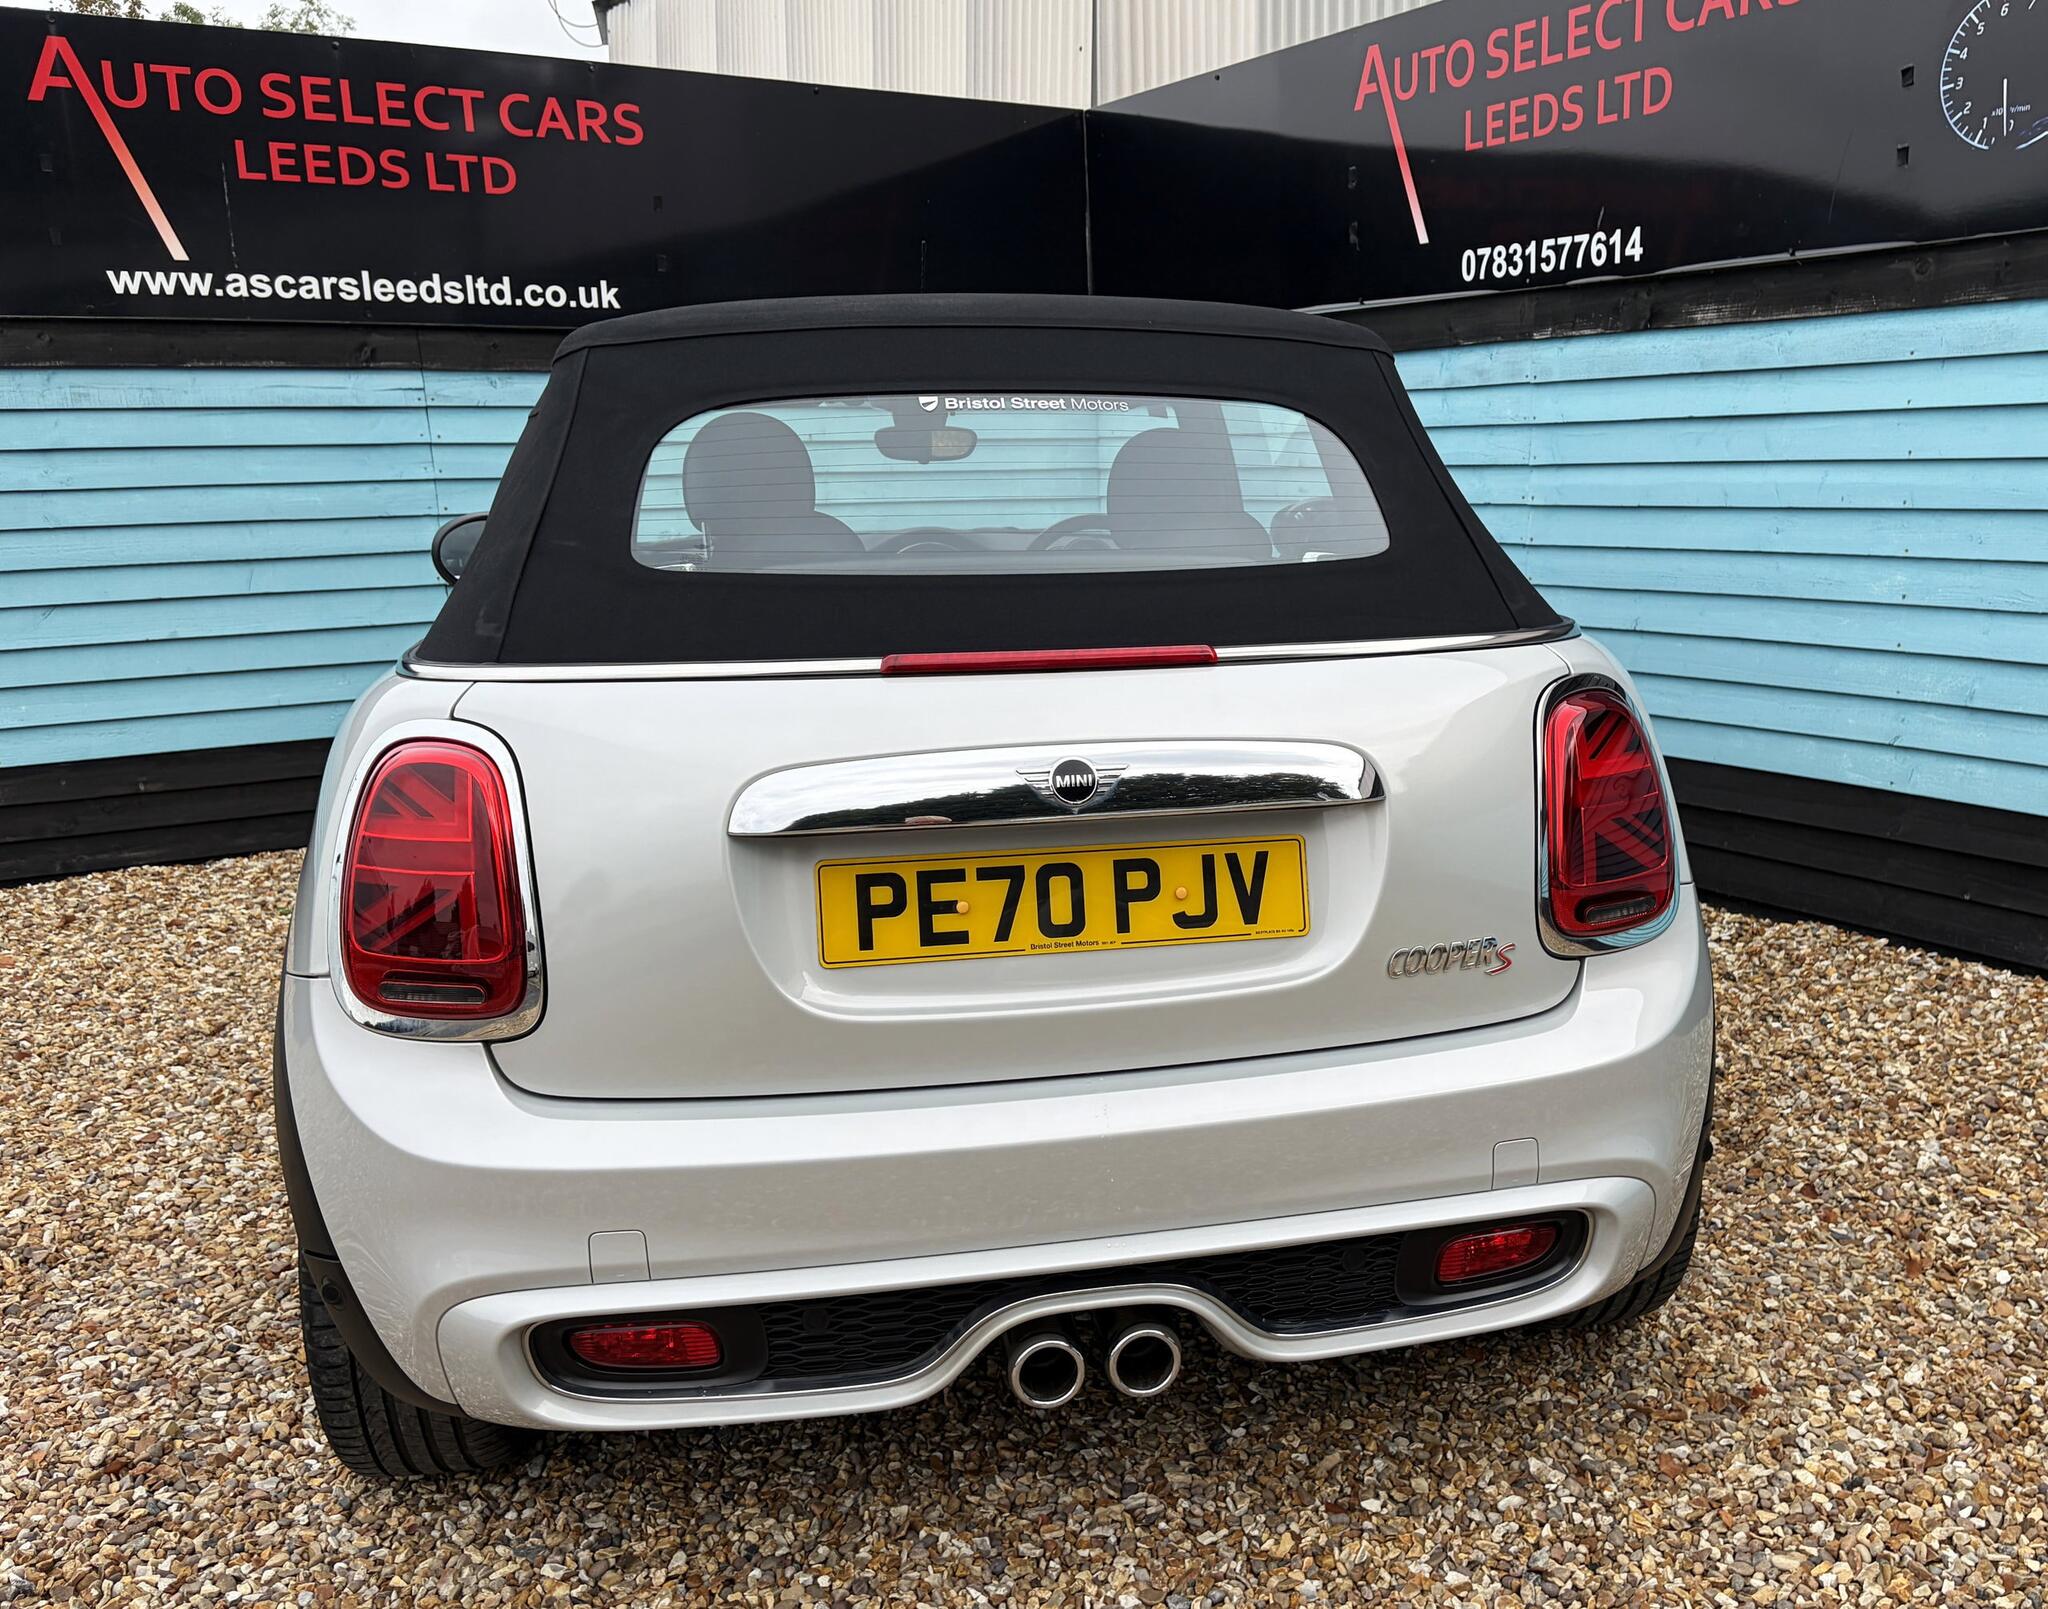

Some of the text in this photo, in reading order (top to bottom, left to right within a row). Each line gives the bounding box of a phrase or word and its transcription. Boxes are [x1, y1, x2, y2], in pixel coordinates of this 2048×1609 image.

[2000, 2, 2010, 17] 6
[1977, 22, 1985, 35] 5
[1486, 0, 1650, 79] SELECT
[1959, 47, 1968, 60] 4
[1955, 77, 1964, 90] 3
[259, 72, 485, 134] SELECT
[498, 93, 645, 146] CARS
[1464, 66, 1673, 152] LEEDS LTD
[1963, 102, 1972, 115] 2
[1982, 116, 1988, 130] 1
[233, 139, 517, 196] LEEDS LTD
[1461, 225, 1644, 283] 07831577614
[106, 269, 621, 310] www.ascarsleedsltd.co.uk
[944, 397, 1129, 412] Bristol Street Motors
[1055, 773, 1093, 788] MINI
[855, 850, 1269, 952] PE70 PJV
[1075, 940, 1100, 948] Motors
[1387, 936, 1516, 979] COOPER S
